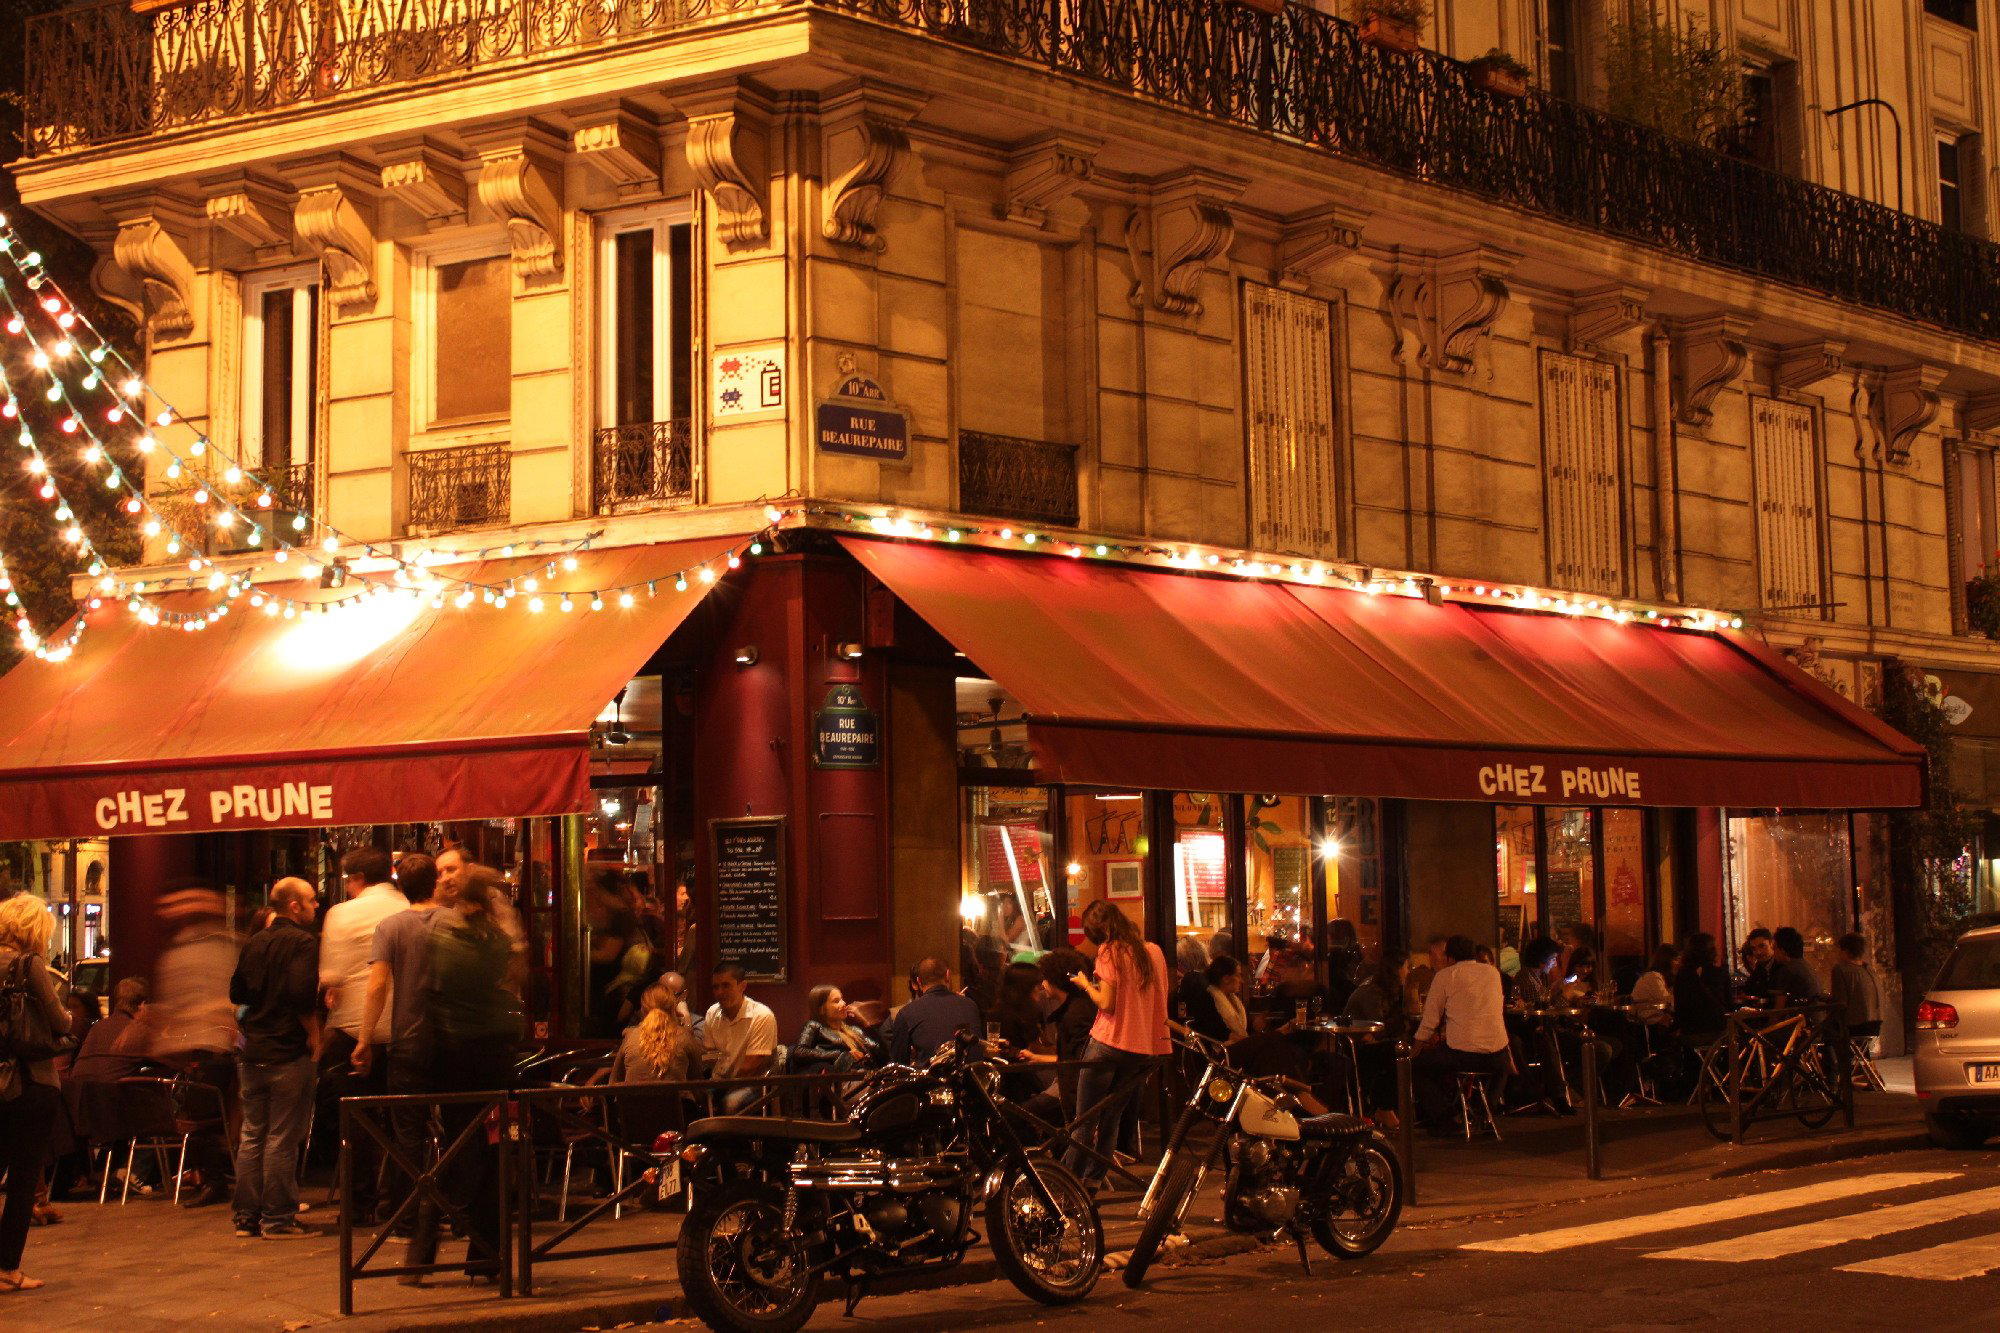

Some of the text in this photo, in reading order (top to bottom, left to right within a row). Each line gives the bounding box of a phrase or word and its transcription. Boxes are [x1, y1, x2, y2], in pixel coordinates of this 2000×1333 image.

[850, 417, 876, 430] RUE
[822, 430, 904, 451] BEAUREPAIRE
[839, 718, 855, 728] RUE
[820, 732, 874, 743] BEAUREPAIRE
[1478, 763, 1641, 799] CHEZ PRUNE
[95, 782, 334, 830] CHEZ PRUNE
